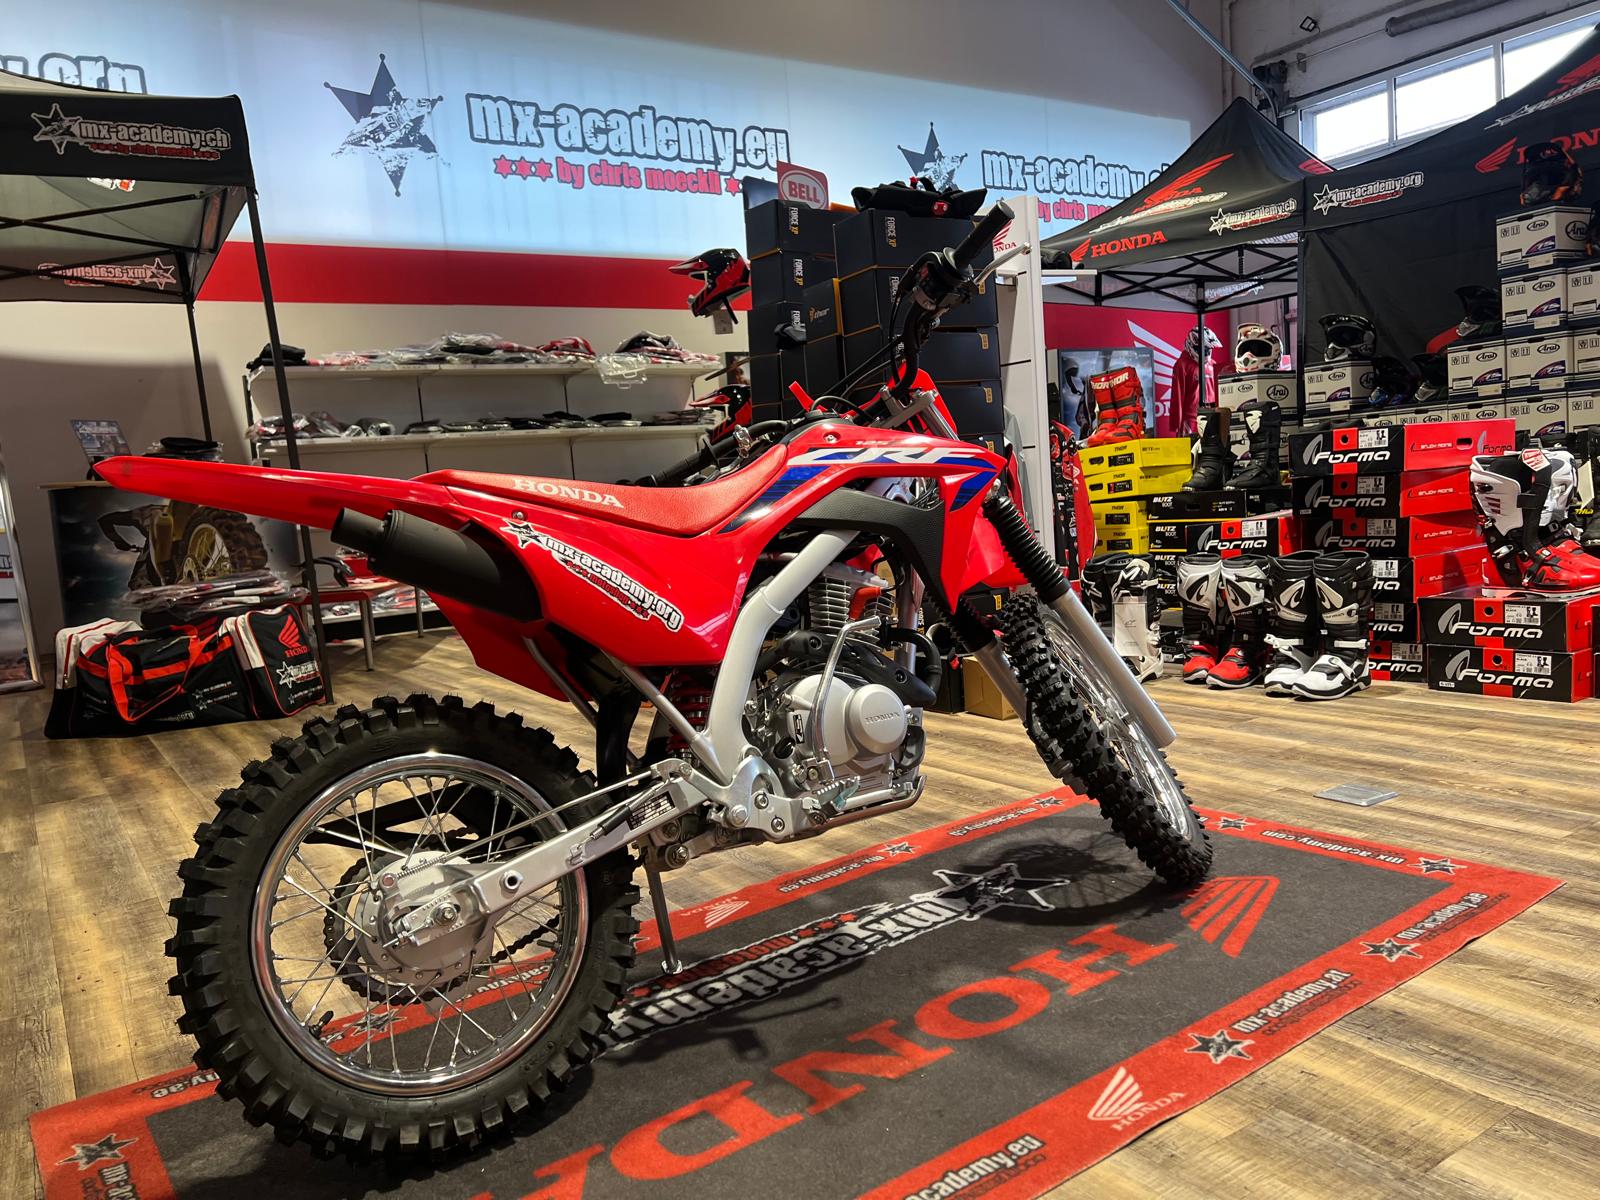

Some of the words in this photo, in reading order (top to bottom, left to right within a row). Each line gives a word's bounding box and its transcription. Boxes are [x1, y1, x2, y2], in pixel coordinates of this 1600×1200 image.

[80, 120, 230, 150] mx-academy.ch
[466, 93, 791, 175] mx-academy.eu
[555, 156, 584, 190] by
[588, 159, 642, 189] chris
[645, 166, 723, 195] moeckli
[982, 149, 1171, 200] mx-academy
[787, 180, 820, 203] BELL
[1336, 174, 1423, 202] mx-academy.org
[791, 207, 799, 225] FORCE
[1053, 198, 1085, 221] chris
[791, 225, 799, 235] XP
[887, 216, 896, 237] FORCE
[888, 238, 897, 248] XP
[994, 241, 1017, 252] ONDA
[1091, 230, 1168, 259] HONDA
[1268, 385, 1288, 396] Arai
[787, 447, 986, 465] CRF
[1312, 451, 1390, 465] Forma
[512, 478, 625, 509] HONDA
[1313, 496, 1387, 508] Forma
[1206, 539, 1268, 551] Forma
[1325, 536, 1396, 548] Forma
[546, 537, 683, 631] mx-academy.org
[1450, 622, 1544, 639] Forma
[284, 645, 309, 657] HOND
[1367, 661, 1422, 673] orma
[1458, 668, 1554, 689] Forma
[865, 712, 901, 724] HONDA
[1262, 830, 1406, 865] mx-academy.com
[779, 854, 886, 893] mx-academy.eu
[1396, 891, 1490, 941] mx-academy.ae
[604, 899, 962, 1042] mx-academy
[1231, 968, 1354, 1034] mx-academy.at
[1113, 1090, 1188, 1132] HONDA
